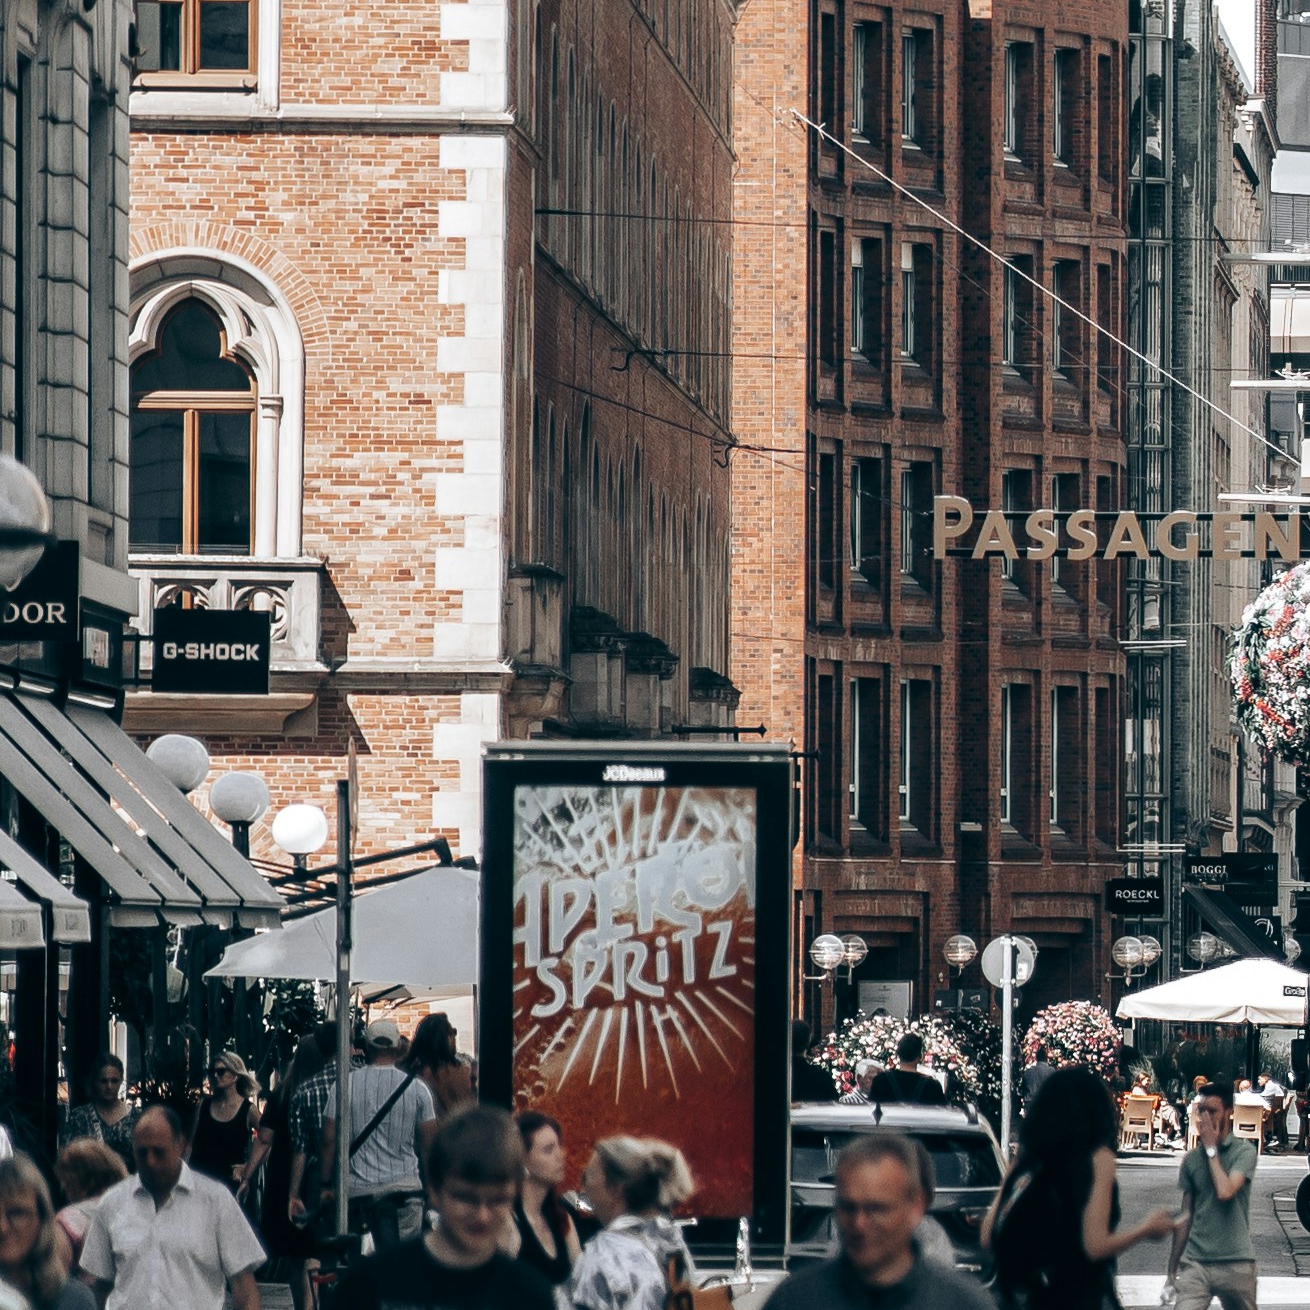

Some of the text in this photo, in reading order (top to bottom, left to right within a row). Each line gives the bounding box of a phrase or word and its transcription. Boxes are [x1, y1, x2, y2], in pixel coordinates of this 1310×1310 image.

[162, 643, 260, 661] G-SHOCK
[1190, 864, 1227, 874] BOGGI
[1115, 889, 1160, 899] ROECKL
